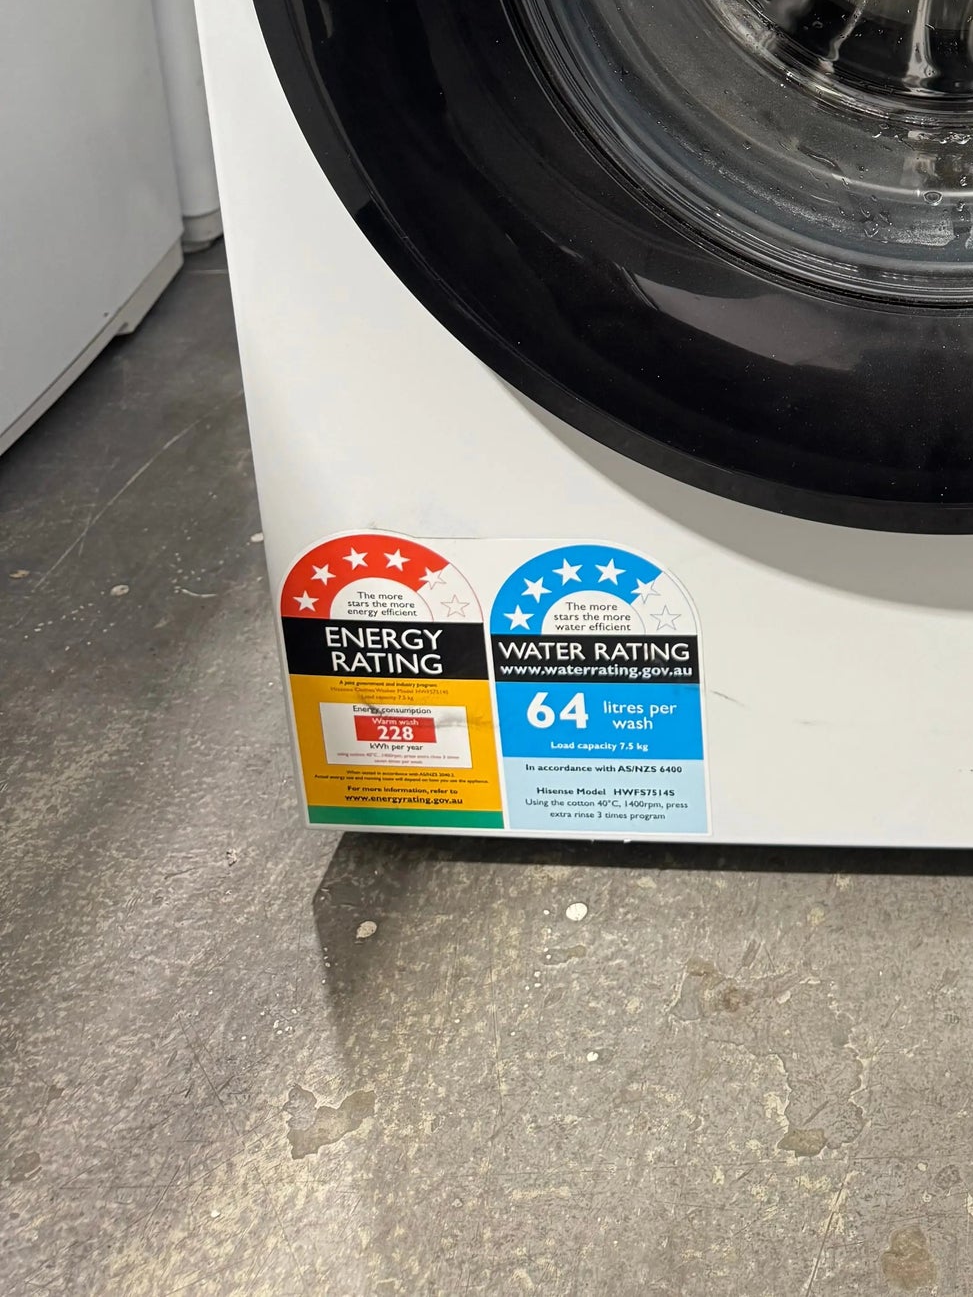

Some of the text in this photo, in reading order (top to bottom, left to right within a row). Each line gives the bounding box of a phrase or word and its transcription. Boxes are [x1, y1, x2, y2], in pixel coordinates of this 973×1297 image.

[357, 591, 376, 600] The
[565, 601, 618, 611] The more
[347, 608, 417, 618] energy efficient
[553, 613, 631, 621] stars the more
[589, 622, 632, 632] efficient
[324, 626, 443, 651] ENERGY
[498, 641, 690, 662] WATER RATING
[331, 651, 443, 675] RATING
[500, 663, 693, 679] www.waterrating.gov.au
[352, 705, 432, 715] Energy consumption
[526, 691, 677, 729] 64 litres per
[371, 717, 419, 726] Warm wash
[612, 716, 654, 730] wash
[376, 725, 414, 741] 228
[391, 744, 404, 752] per
[550, 741, 649, 752] Load capacity 7.5 kg
[525, 763, 683, 774] In accordance with AS/NZS 6400
[383, 786, 430, 795] information,
[536, 787, 676, 797] Hisense Model HWFS7514S
[344, 794, 463, 805] www.energyrating.gov.au
[524, 798, 549, 807] Using
[550, 798, 565, 806] the
[566, 799, 595, 807] cotton
[624, 800, 664, 810] 1400rpm,
[666, 801, 688, 810] press
[574, 811, 595, 819] rinse
[604, 811, 628, 819] times
[629, 813, 666, 821] program
